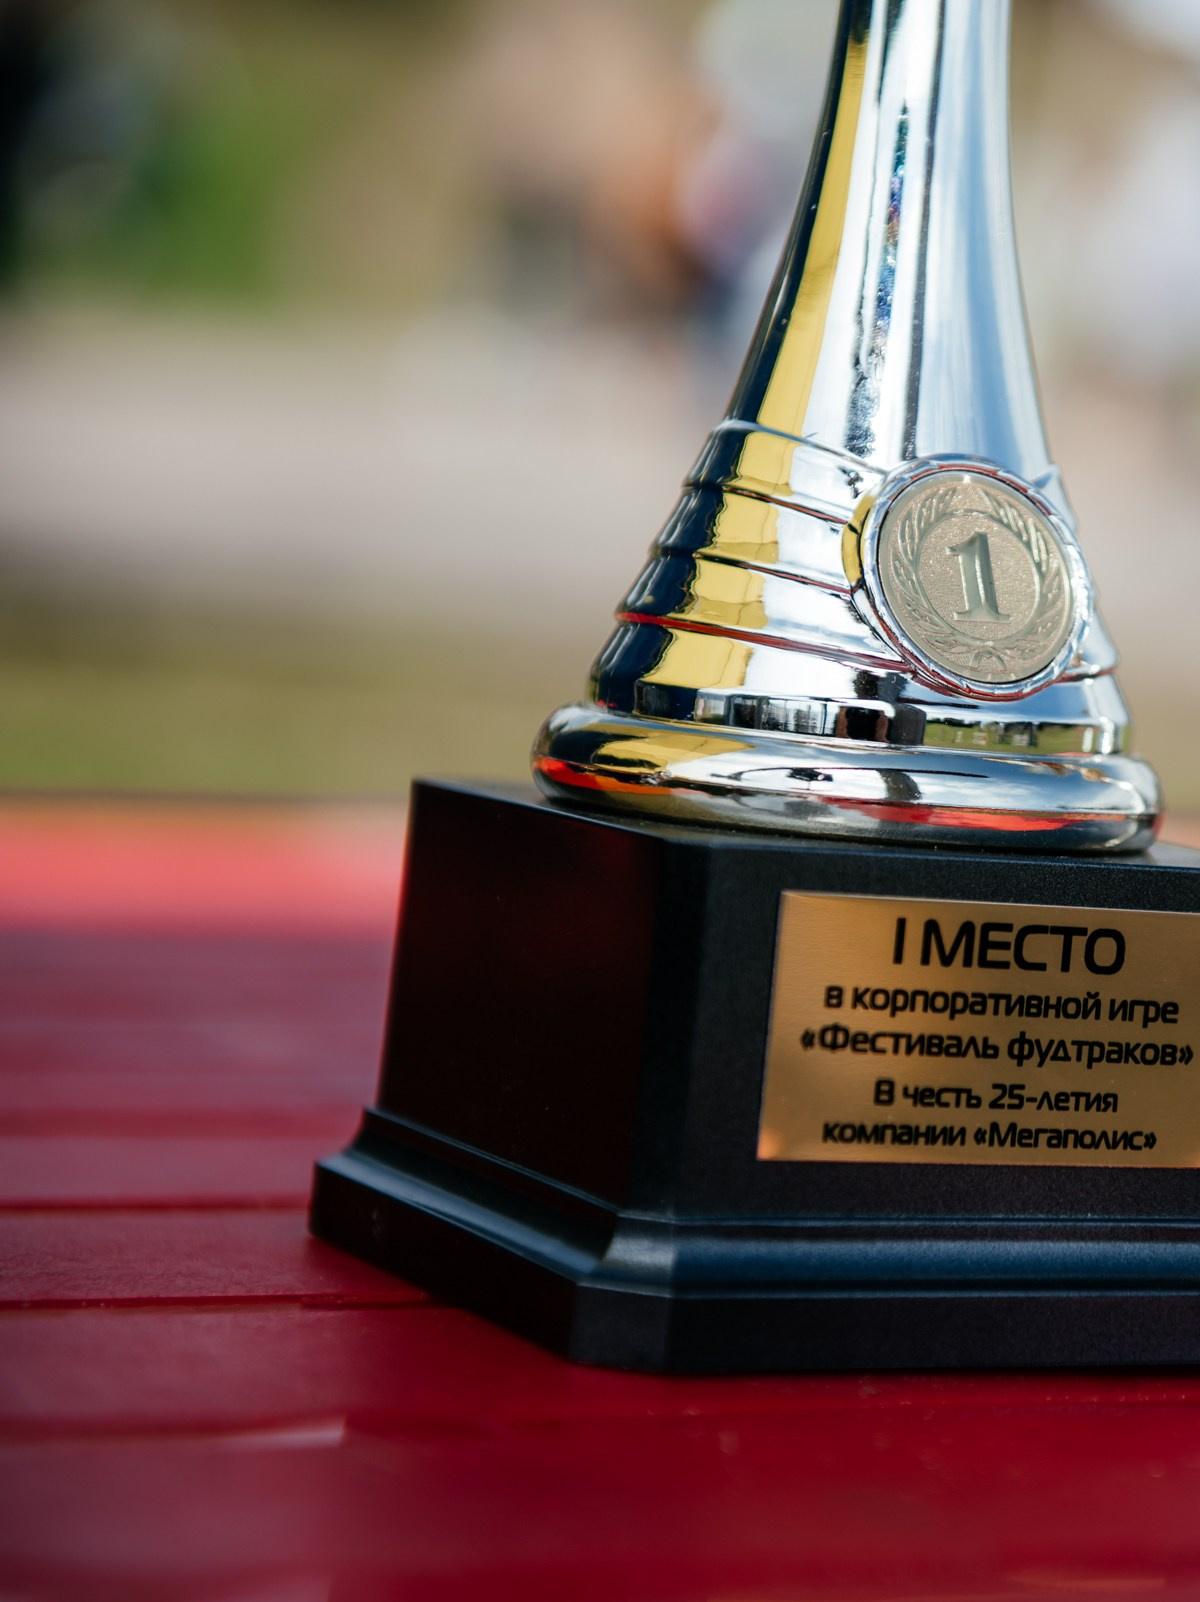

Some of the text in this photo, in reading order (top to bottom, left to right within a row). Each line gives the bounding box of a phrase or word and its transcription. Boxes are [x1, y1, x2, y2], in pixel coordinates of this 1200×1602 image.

[945, 531, 1012, 624] 1
[919, 918, 1127, 976] МЕСТО
[824, 985, 1180, 1029] в корпоративной игре
[800, 1022, 1194, 1069] «Фестиваль фудтраков»
[873, 1078, 1119, 1114] В честь 25-летия
[822, 1121, 1157, 1152] компании «Мегаполис»
